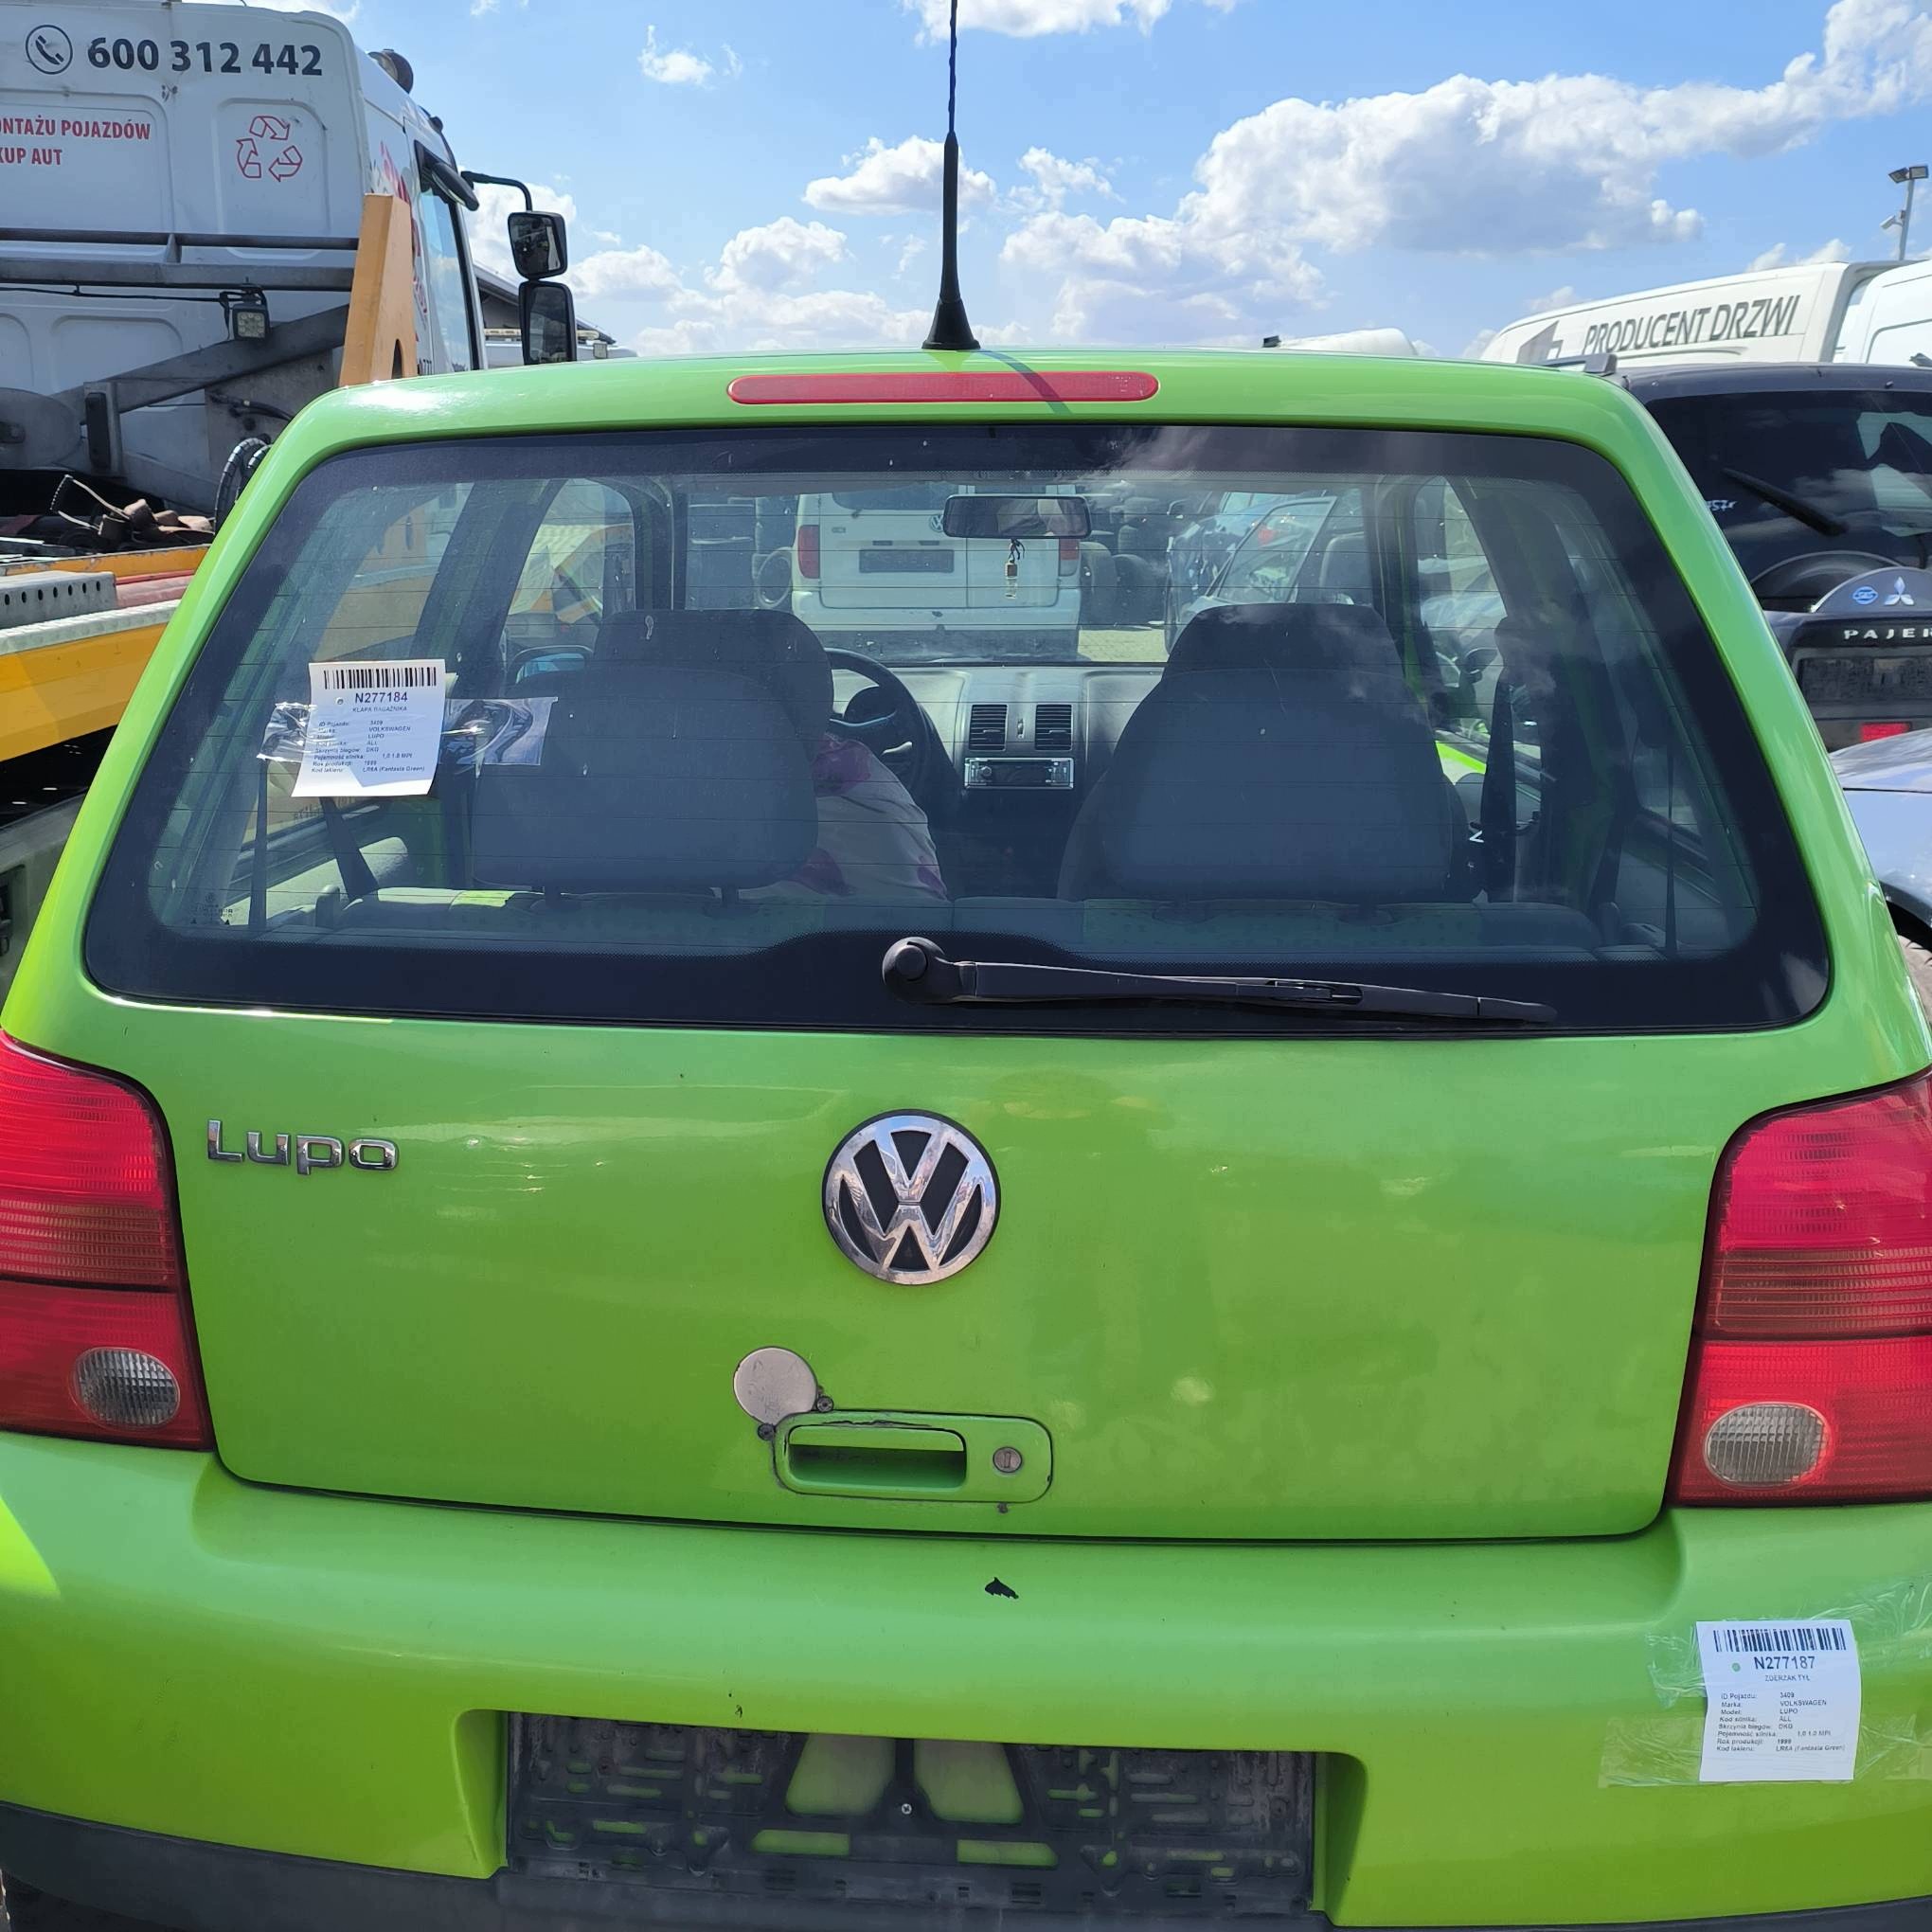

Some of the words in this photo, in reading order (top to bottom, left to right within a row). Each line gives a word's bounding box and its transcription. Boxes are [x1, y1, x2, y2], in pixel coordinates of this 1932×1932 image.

[87, 37, 159, 71] 600
[170, 40, 242, 74] 312
[251, 44, 323, 76] 442
[0, 115, 56, 136] NTAŻU
[61, 118, 151, 140] POJAZDÓW
[31, 148, 63, 165] AUT
[1582, 307, 1711, 354] PRODUCENT
[1709, 295, 1800, 342] DRZWI
[354, 691, 408, 704] N277184
[207, 1119, 400, 1175] Lupo
[1753, 1655, 1816, 1670] N277187
